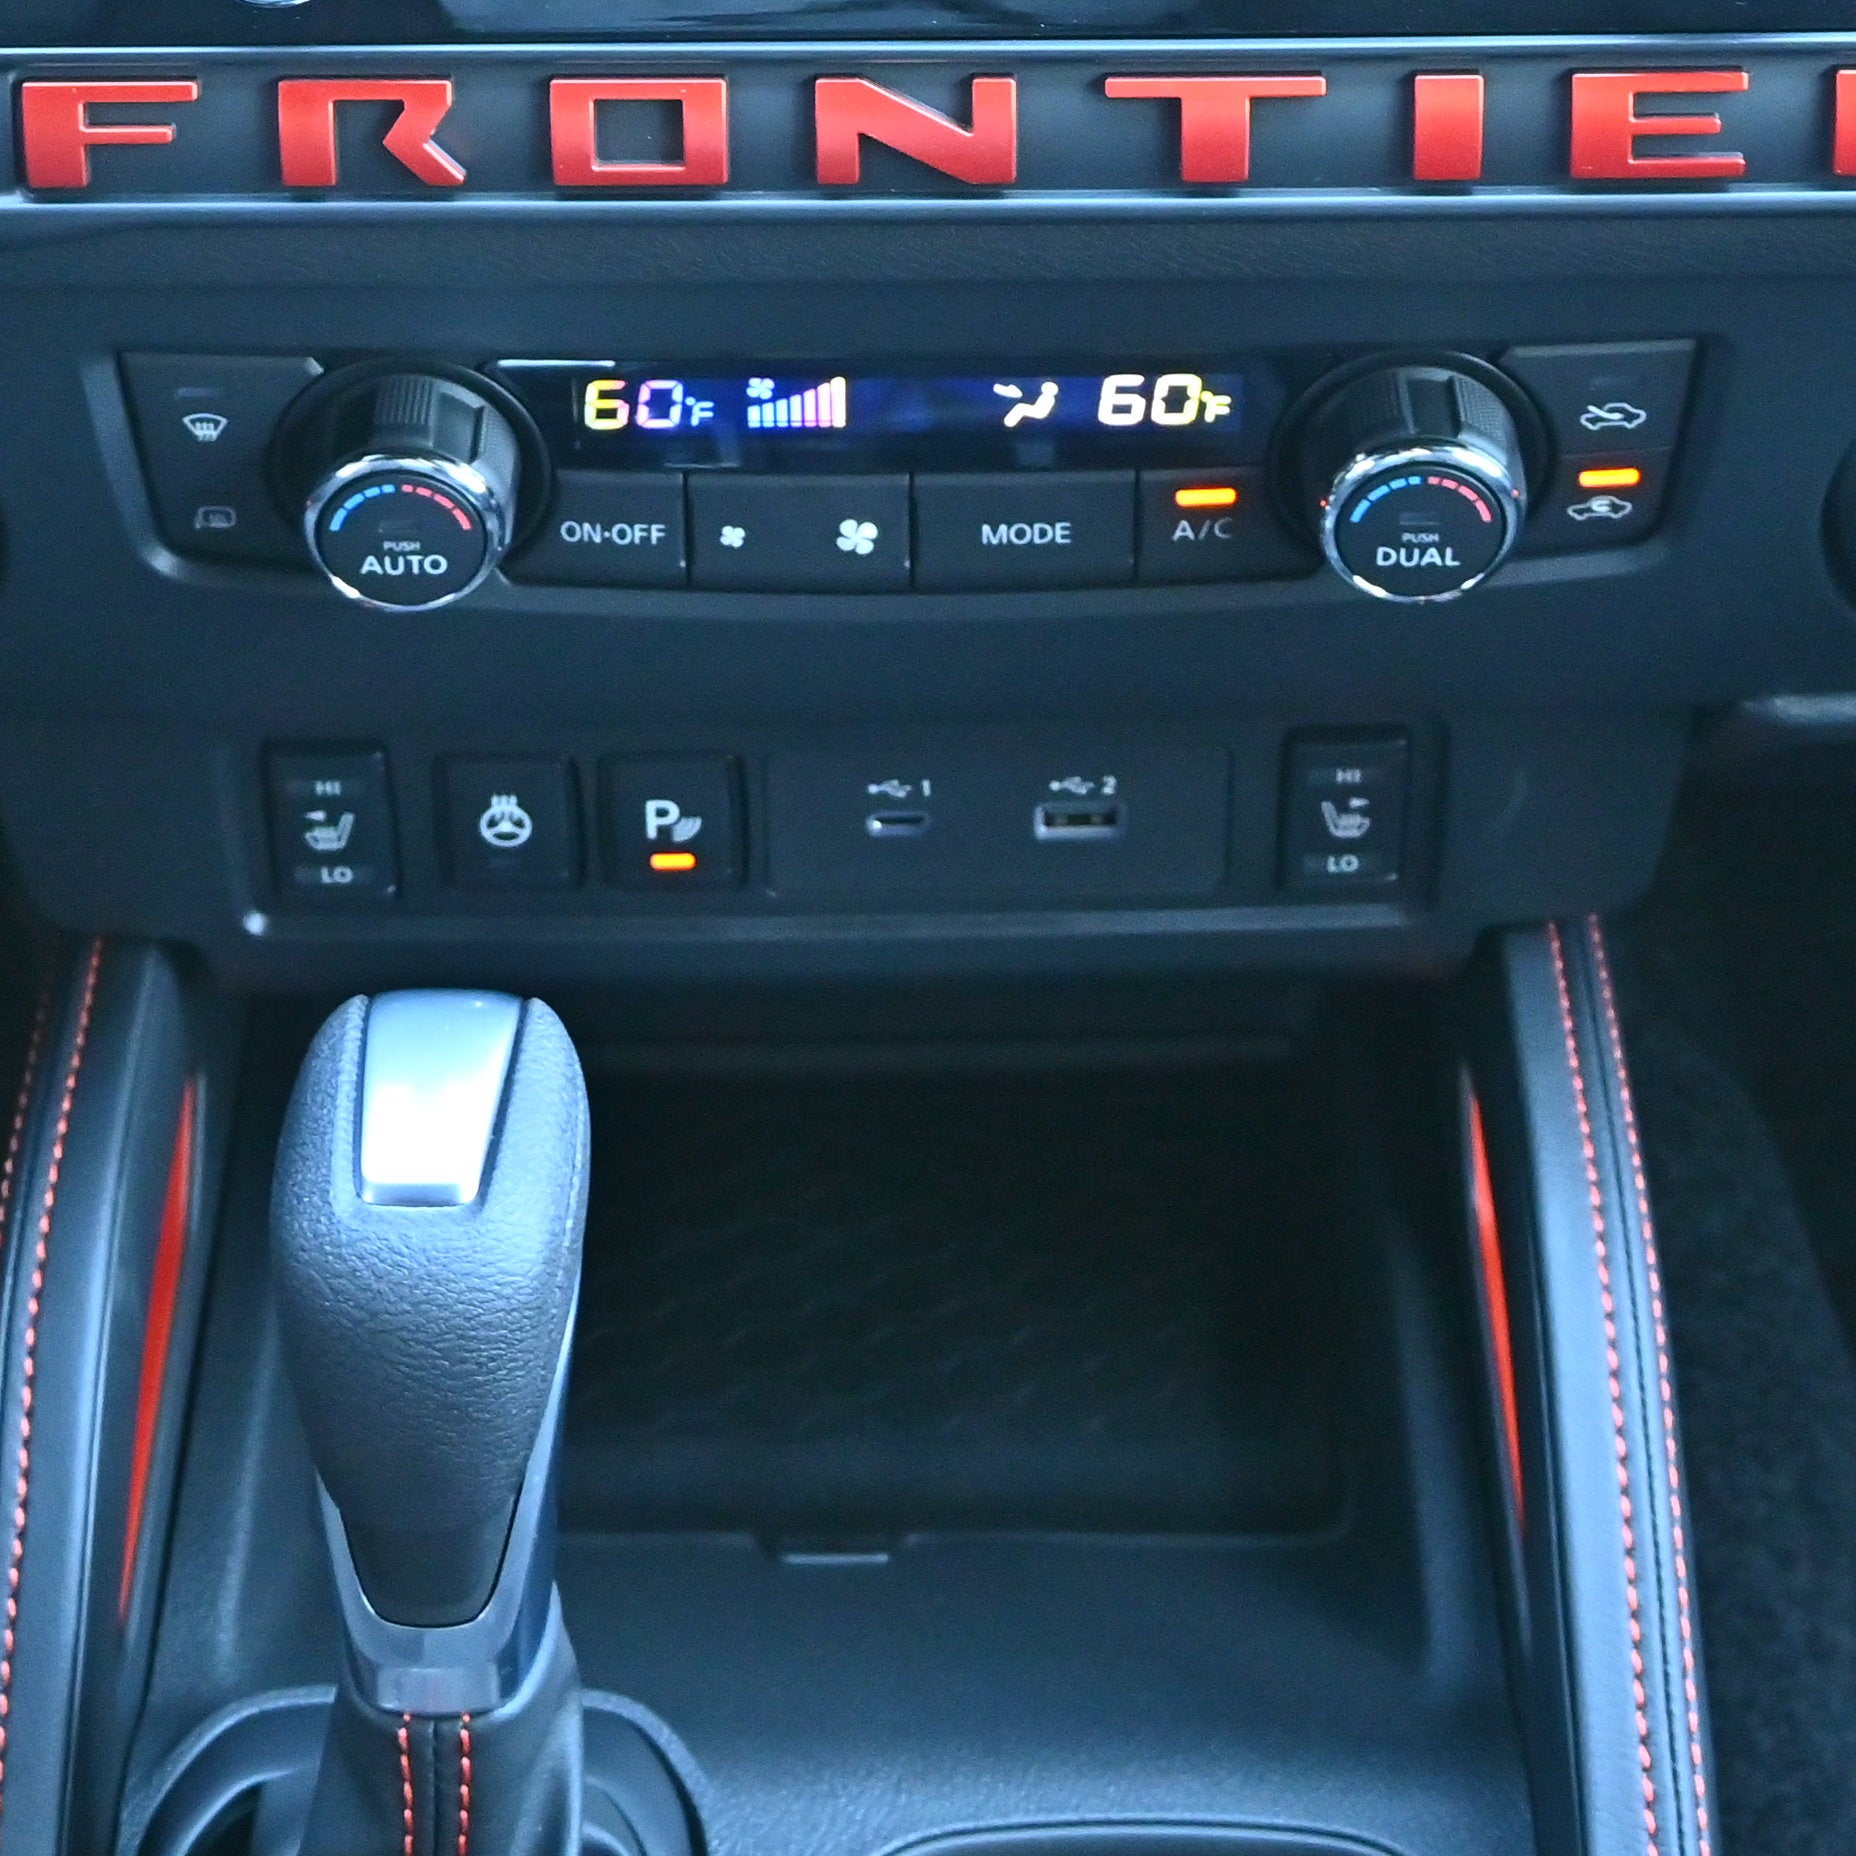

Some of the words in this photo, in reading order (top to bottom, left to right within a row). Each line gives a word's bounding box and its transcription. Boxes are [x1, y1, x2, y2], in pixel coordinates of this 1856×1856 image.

[981, 522, 1072, 546] MODE
[1173, 517, 1233, 542] A/C
[1402, 532, 1439, 543] PUSH
[383, 540, 421, 551] PUSH
[360, 554, 448, 575] AUTO
[1375, 547, 1461, 569] DUAL
[1327, 853, 1360, 873] LO
[321, 866, 354, 884] LO
